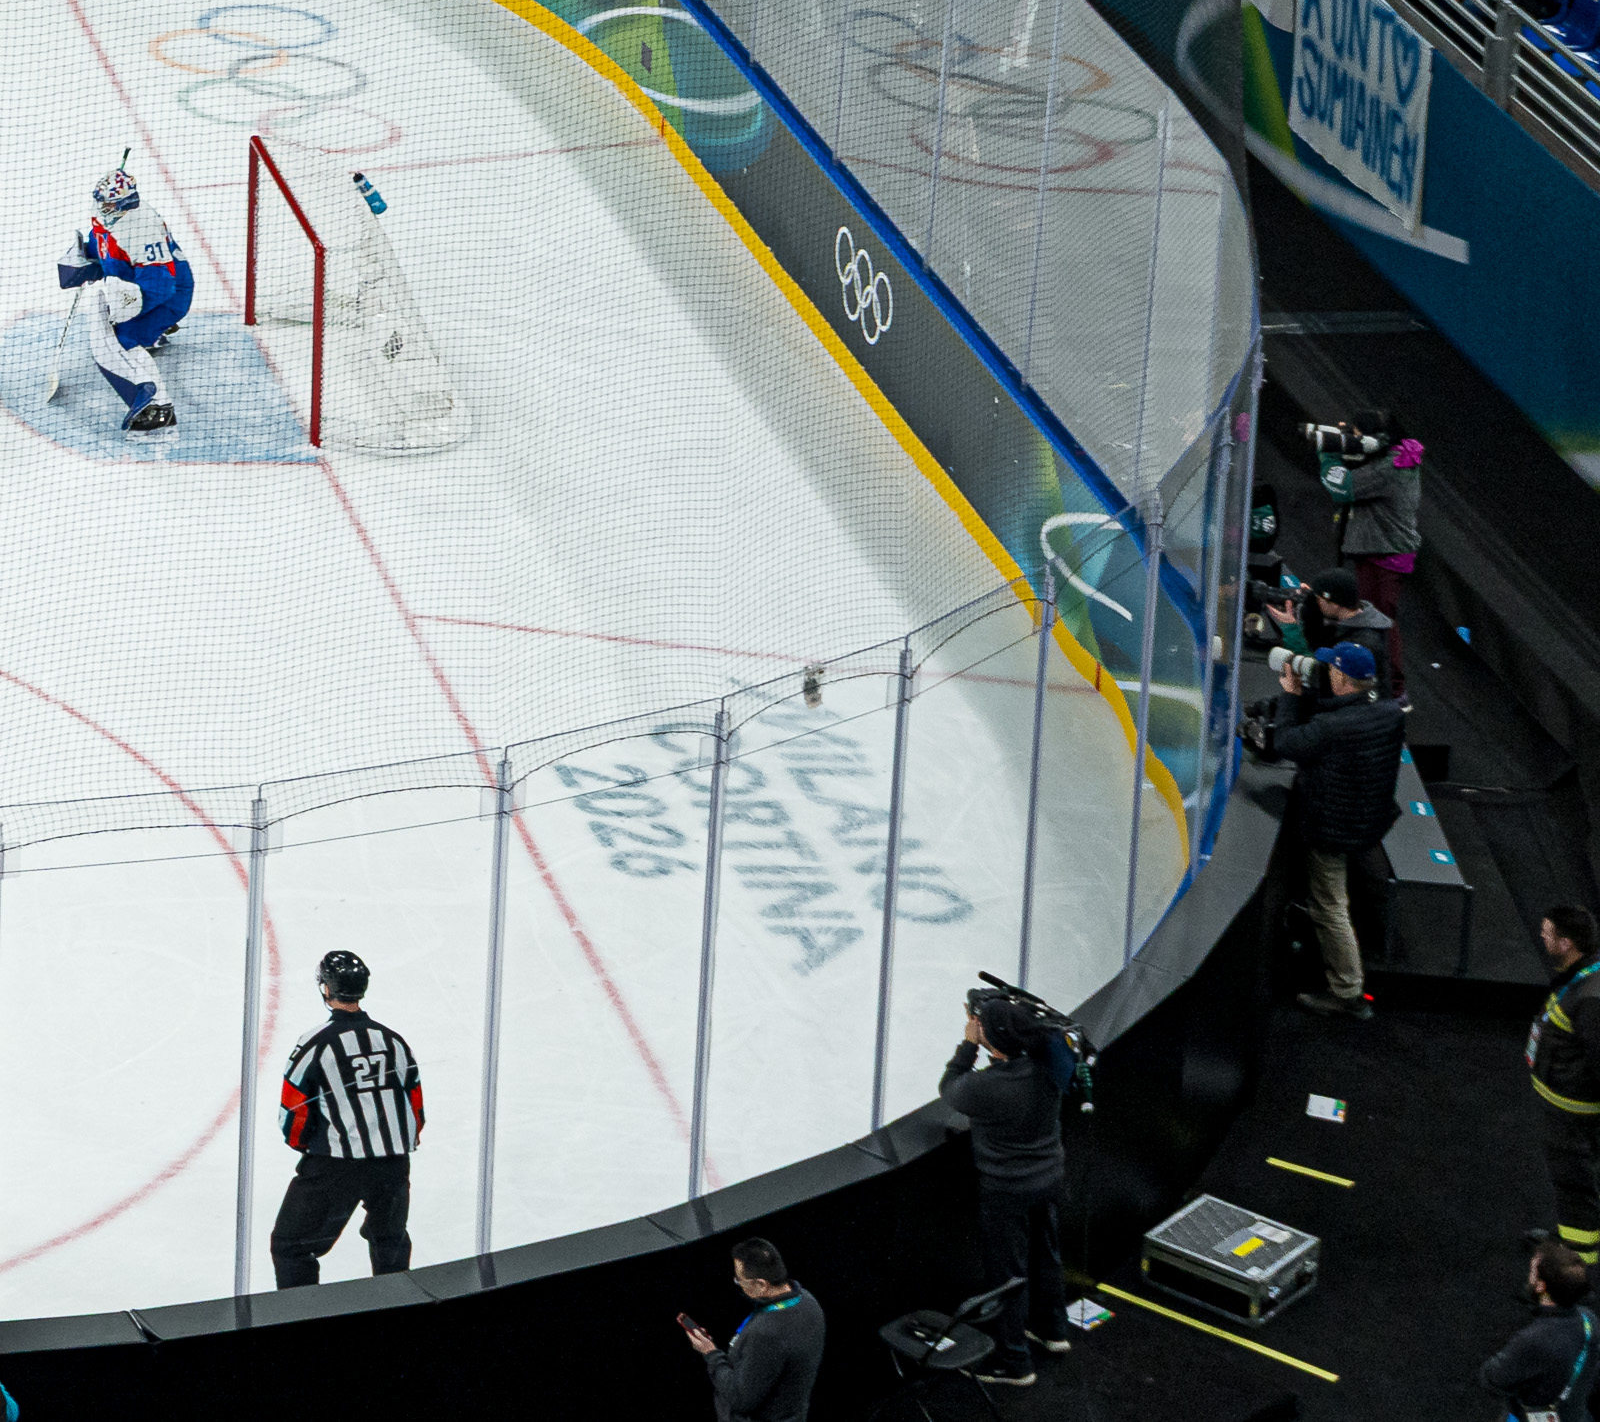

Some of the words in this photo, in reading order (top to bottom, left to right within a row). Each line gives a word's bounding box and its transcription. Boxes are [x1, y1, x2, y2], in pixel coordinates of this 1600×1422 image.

[144, 241, 164, 262] 31
[553, 763, 700, 879] 2026
[650, 721, 865, 977] CORTINA
[730, 677, 975, 925] MILANO
[351, 1053, 387, 1090] 27
